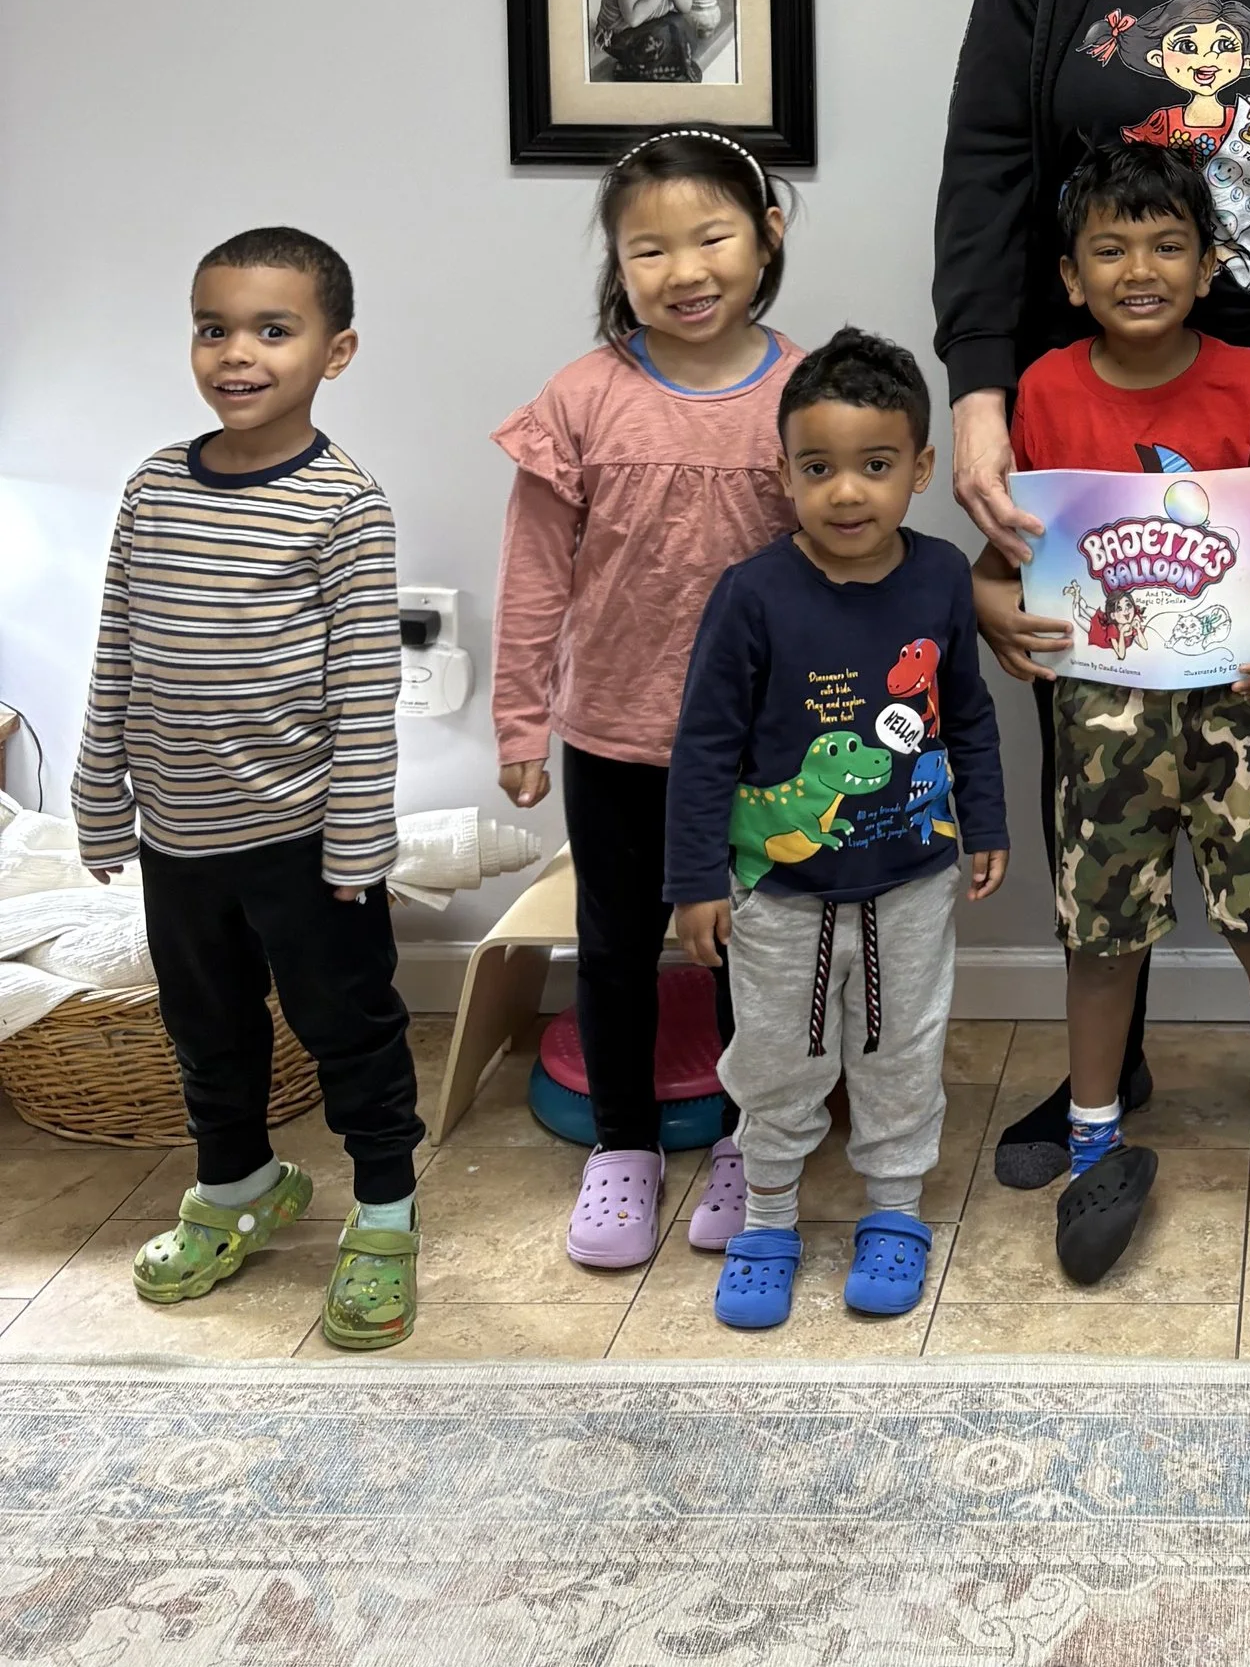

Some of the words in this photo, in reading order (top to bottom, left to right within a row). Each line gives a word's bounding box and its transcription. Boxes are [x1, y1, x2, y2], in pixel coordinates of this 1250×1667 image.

[1083, 520, 1232, 577] BAJETTE'S
[1103, 556, 1201, 592] BALLOON
[805, 699, 824, 713] Play
[826, 697, 840, 709] and
[883, 710, 920, 747] HELLO!
